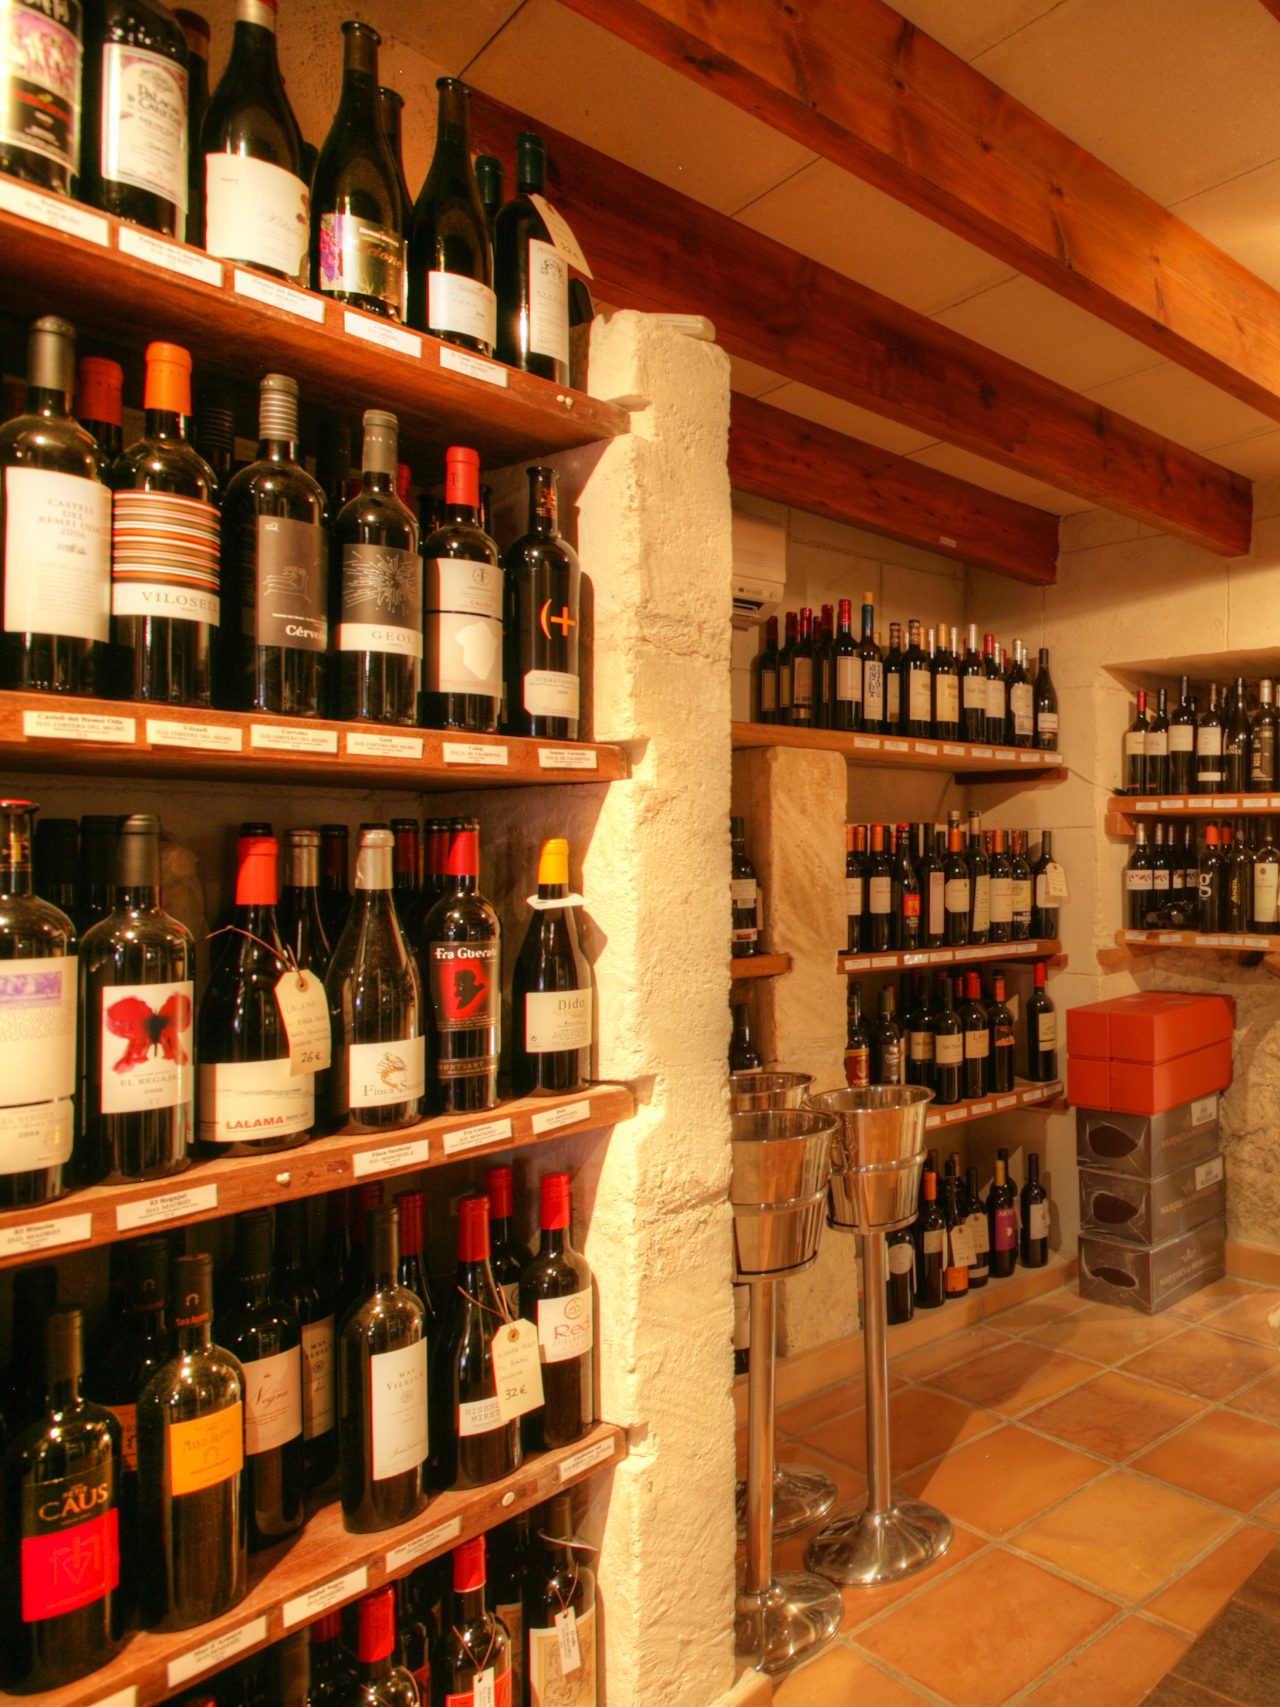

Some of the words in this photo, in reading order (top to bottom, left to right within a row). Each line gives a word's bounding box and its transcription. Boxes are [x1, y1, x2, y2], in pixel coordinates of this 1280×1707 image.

[62, 510, 83, 521] DEL
[558, 998, 585, 1012] Dido
[120, 1079, 134, 1087] EL
[138, 1074, 178, 1086] REGAJA
[363, 1084, 394, 1097] Finca
[226, 1115, 285, 1130] LALAMA
[554, 1315, 590, 1340] Red
[38, 1483, 109, 1521] CAUS
